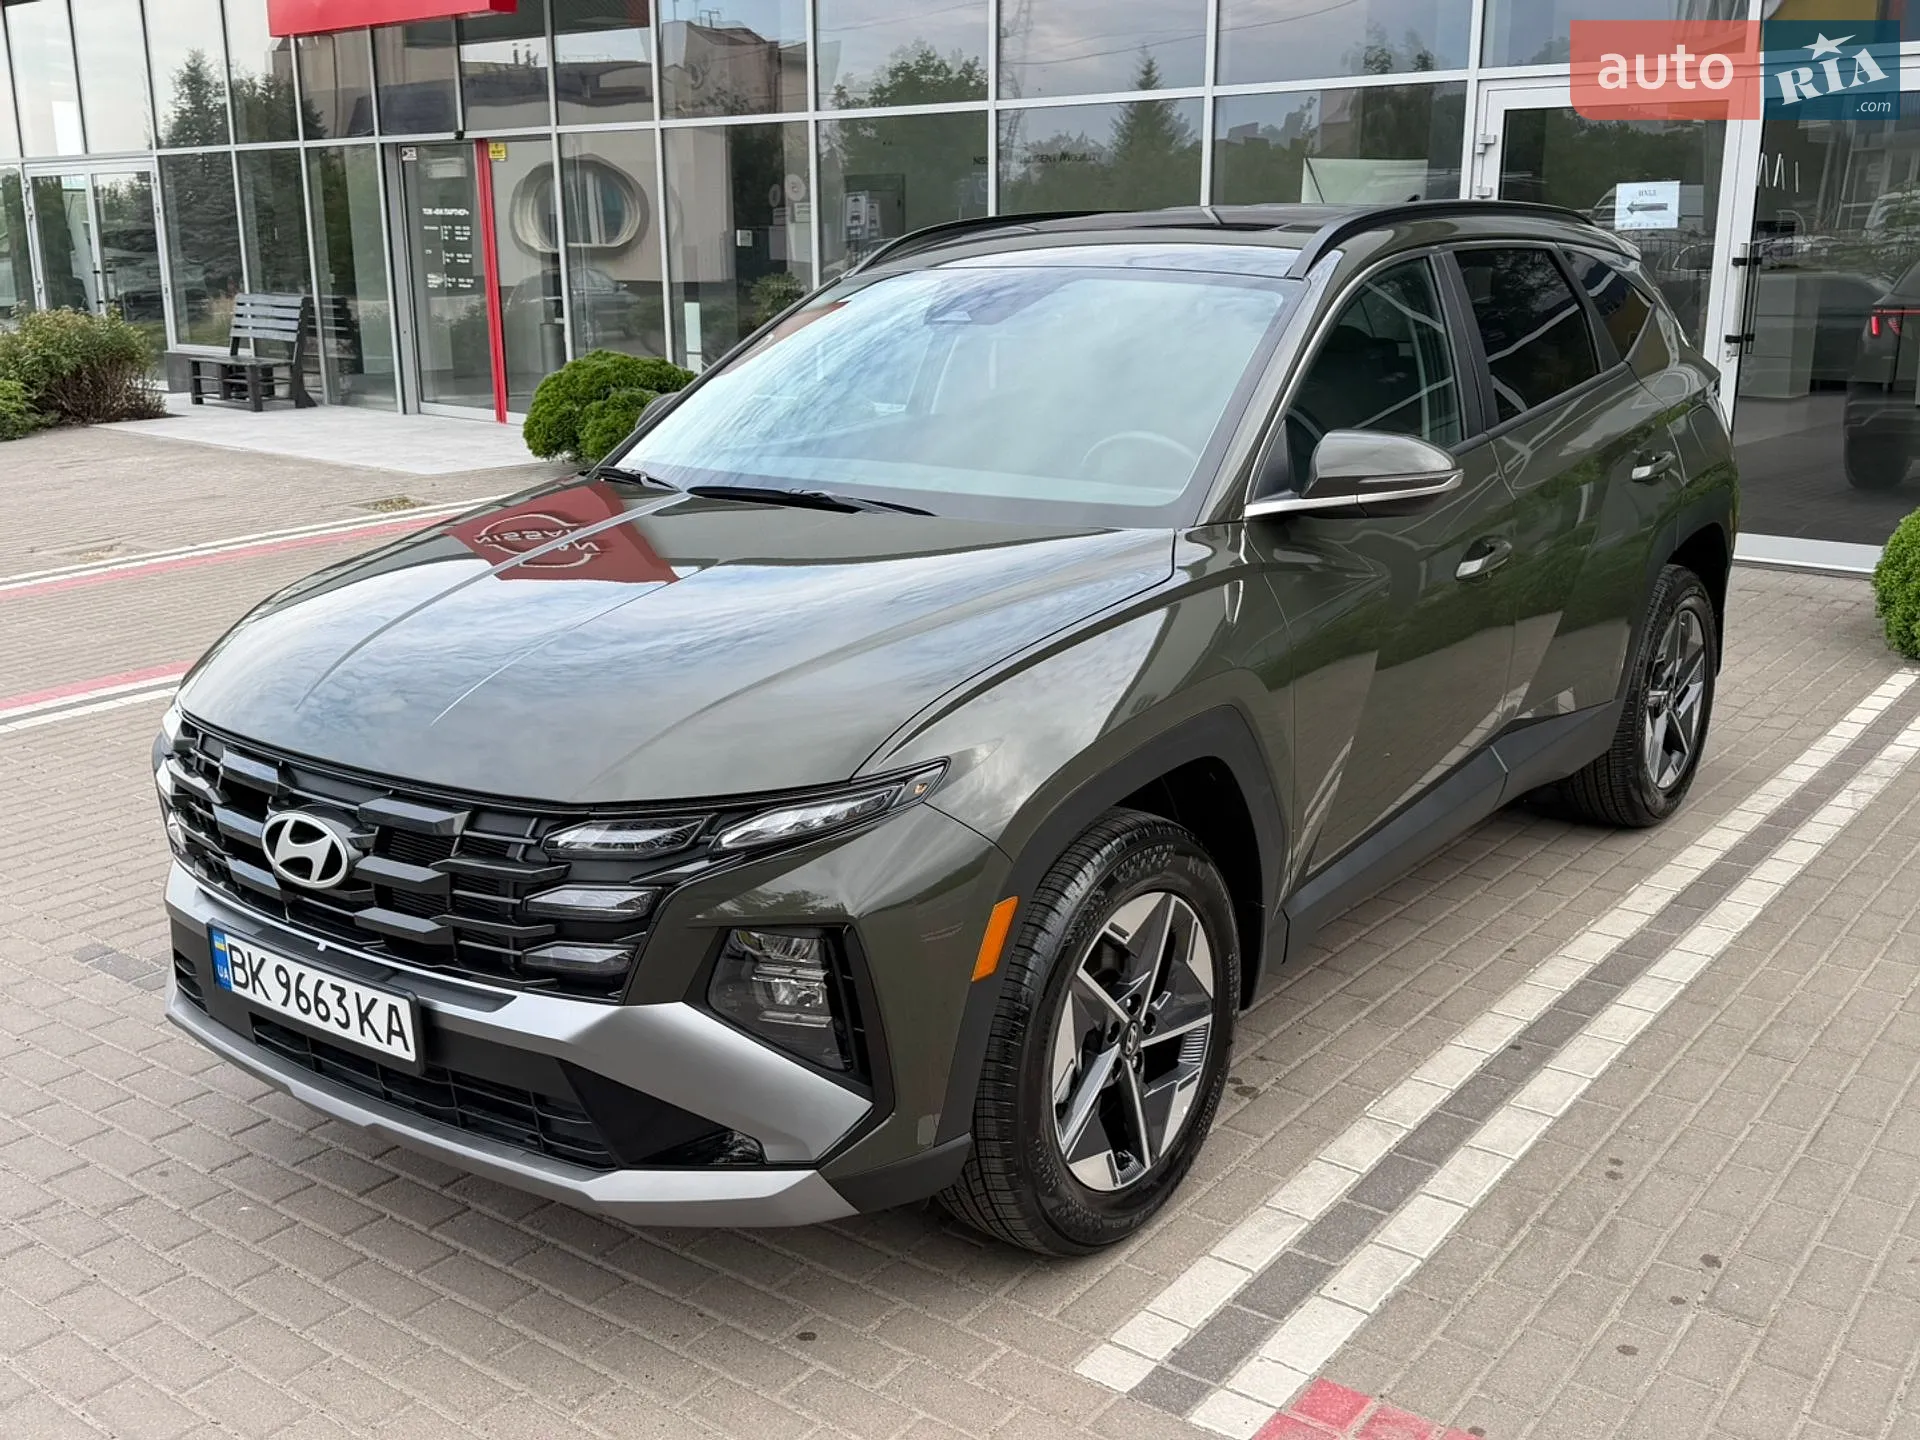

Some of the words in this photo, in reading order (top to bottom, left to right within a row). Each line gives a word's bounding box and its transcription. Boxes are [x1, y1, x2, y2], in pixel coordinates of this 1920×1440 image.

[228, 943, 272, 1001] BK
[274, 963, 351, 1030] 9663
[354, 991, 410, 1052] KA
